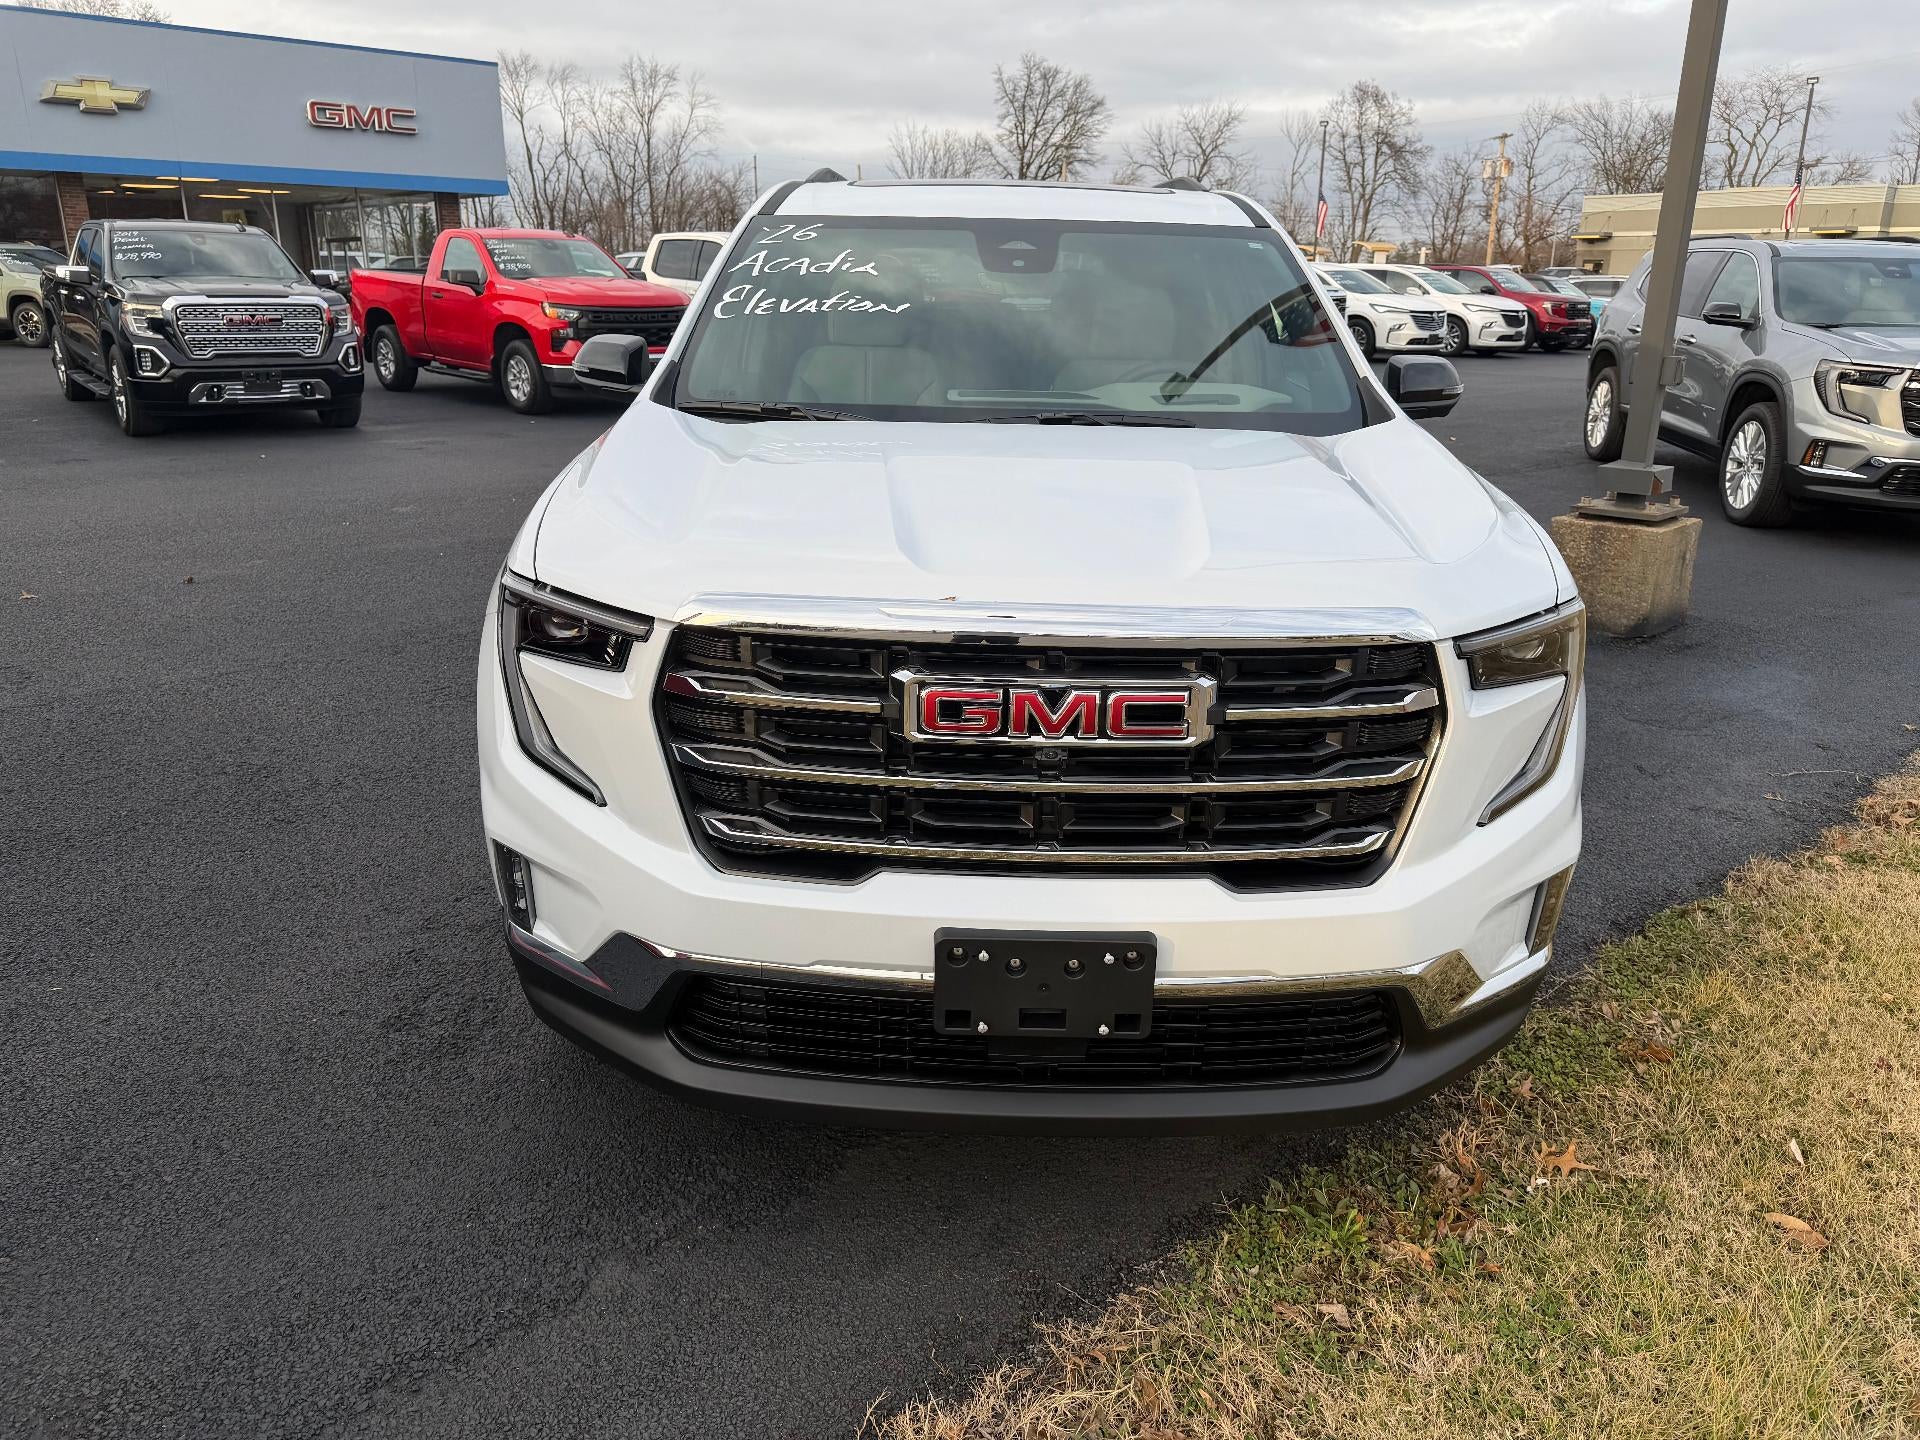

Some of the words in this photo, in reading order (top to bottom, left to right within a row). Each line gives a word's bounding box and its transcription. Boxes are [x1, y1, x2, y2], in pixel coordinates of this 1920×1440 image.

[306, 99, 417, 134] GMC
[223, 314, 283, 327] GMC
[921, 685, 1192, 739] GMC
